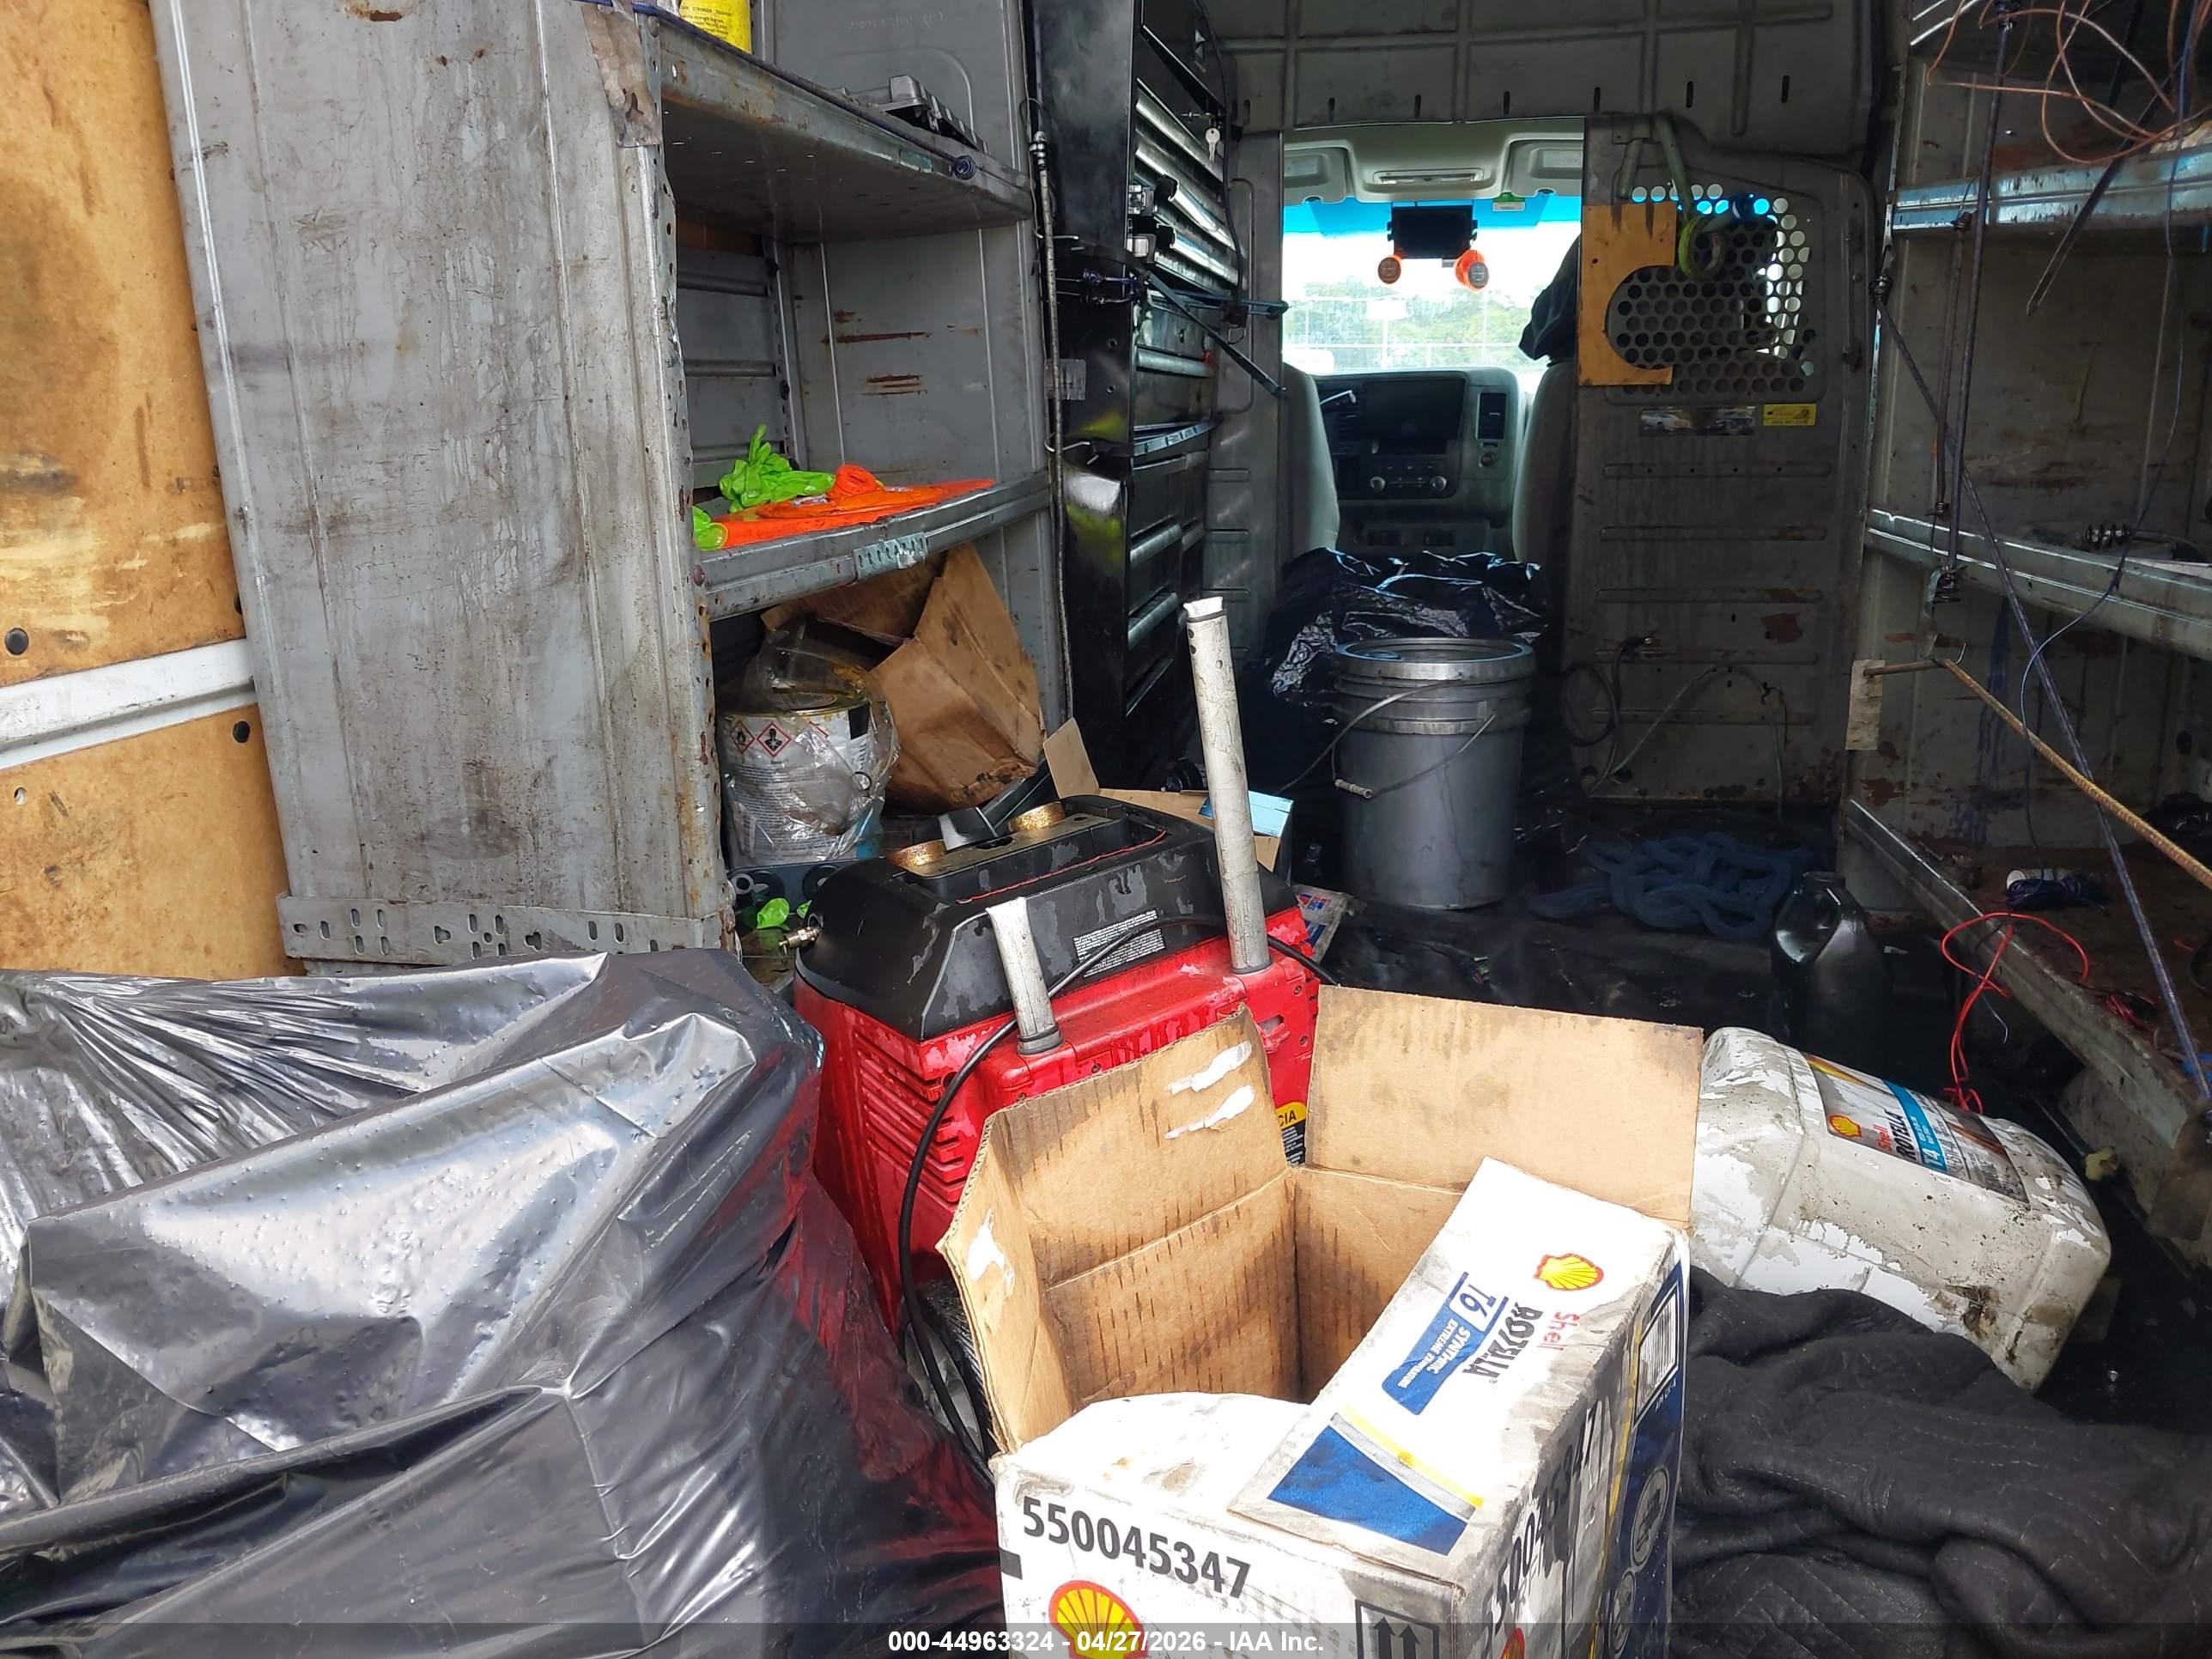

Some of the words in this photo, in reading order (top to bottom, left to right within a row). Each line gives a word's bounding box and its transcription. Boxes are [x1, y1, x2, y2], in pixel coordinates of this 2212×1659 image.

[1873, 1124, 1893, 1152] Shell
[1883, 1108, 1917, 1161] ROTELLA
[1459, 1283, 1498, 1319] T6
[1537, 1310, 1581, 1352] Shell
[1023, 1495, 1252, 1600] 550045347
